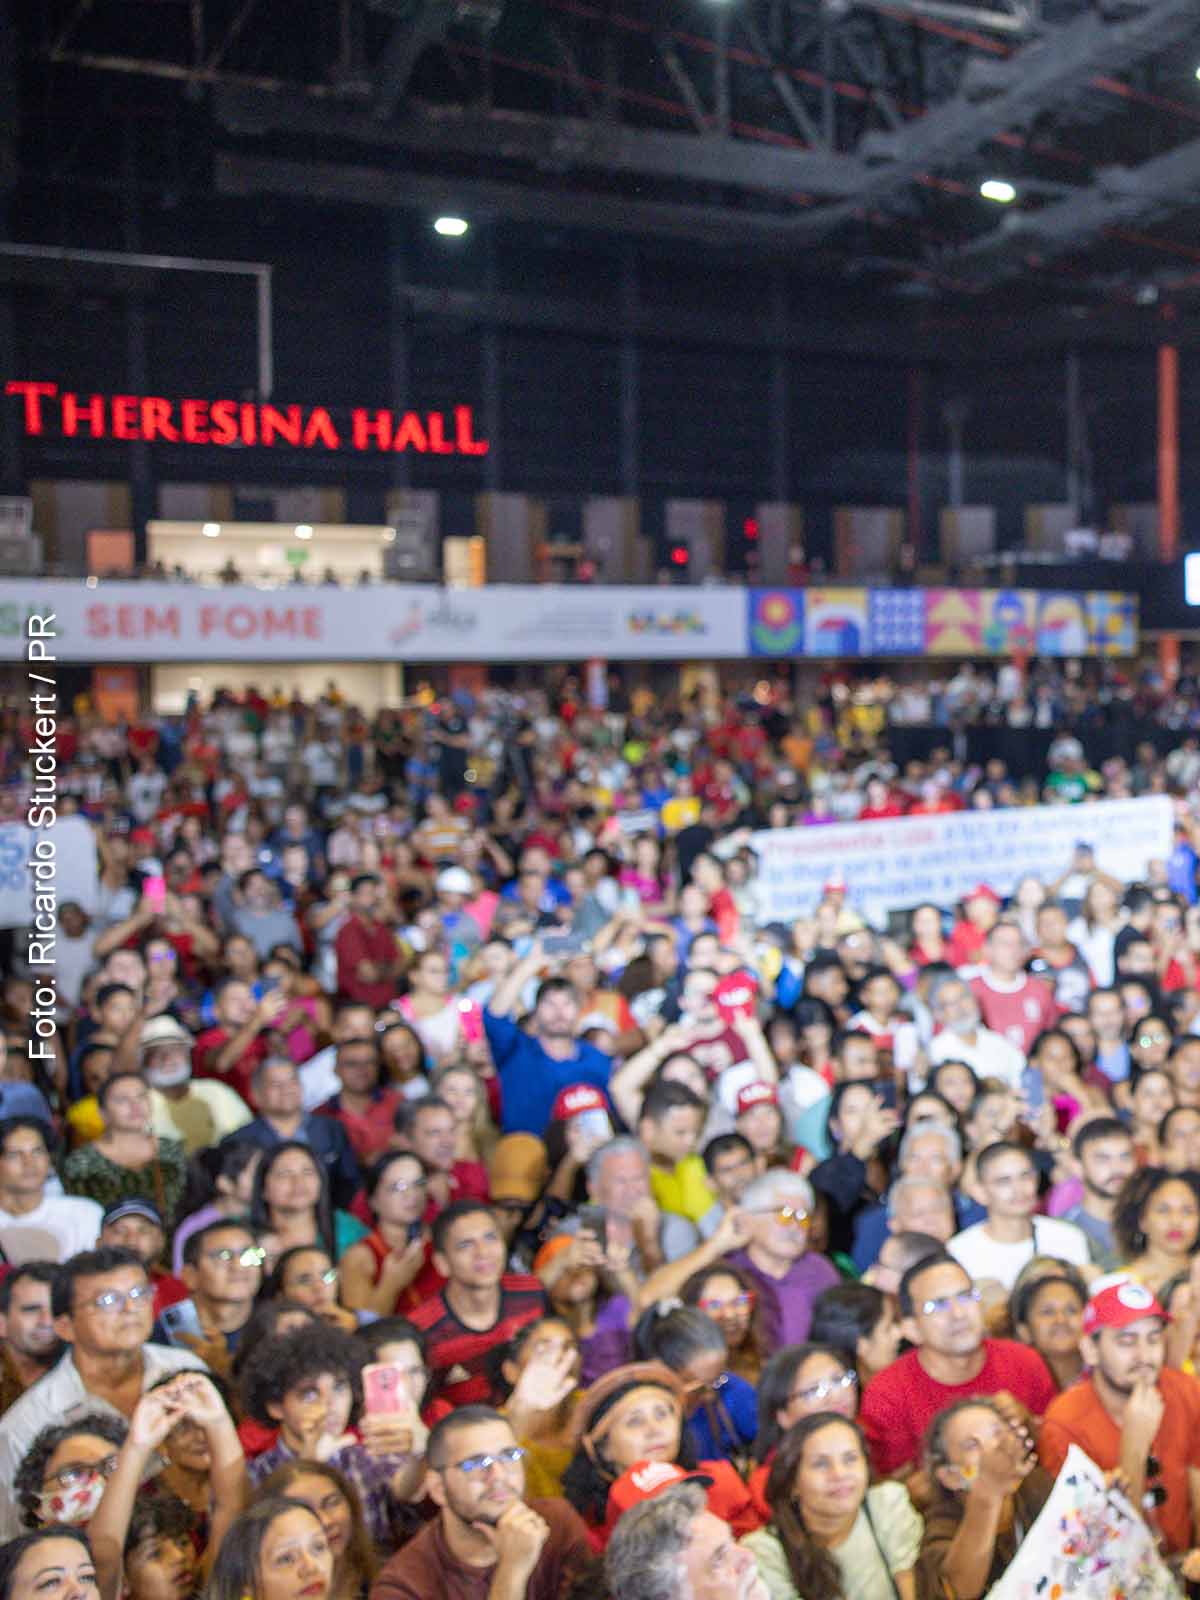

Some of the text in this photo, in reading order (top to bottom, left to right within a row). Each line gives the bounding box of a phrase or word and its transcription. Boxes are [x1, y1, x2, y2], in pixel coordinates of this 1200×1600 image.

[351, 405, 489, 455] HALL
[84, 603, 181, 641] SEM
[198, 603, 322, 641] FOME
